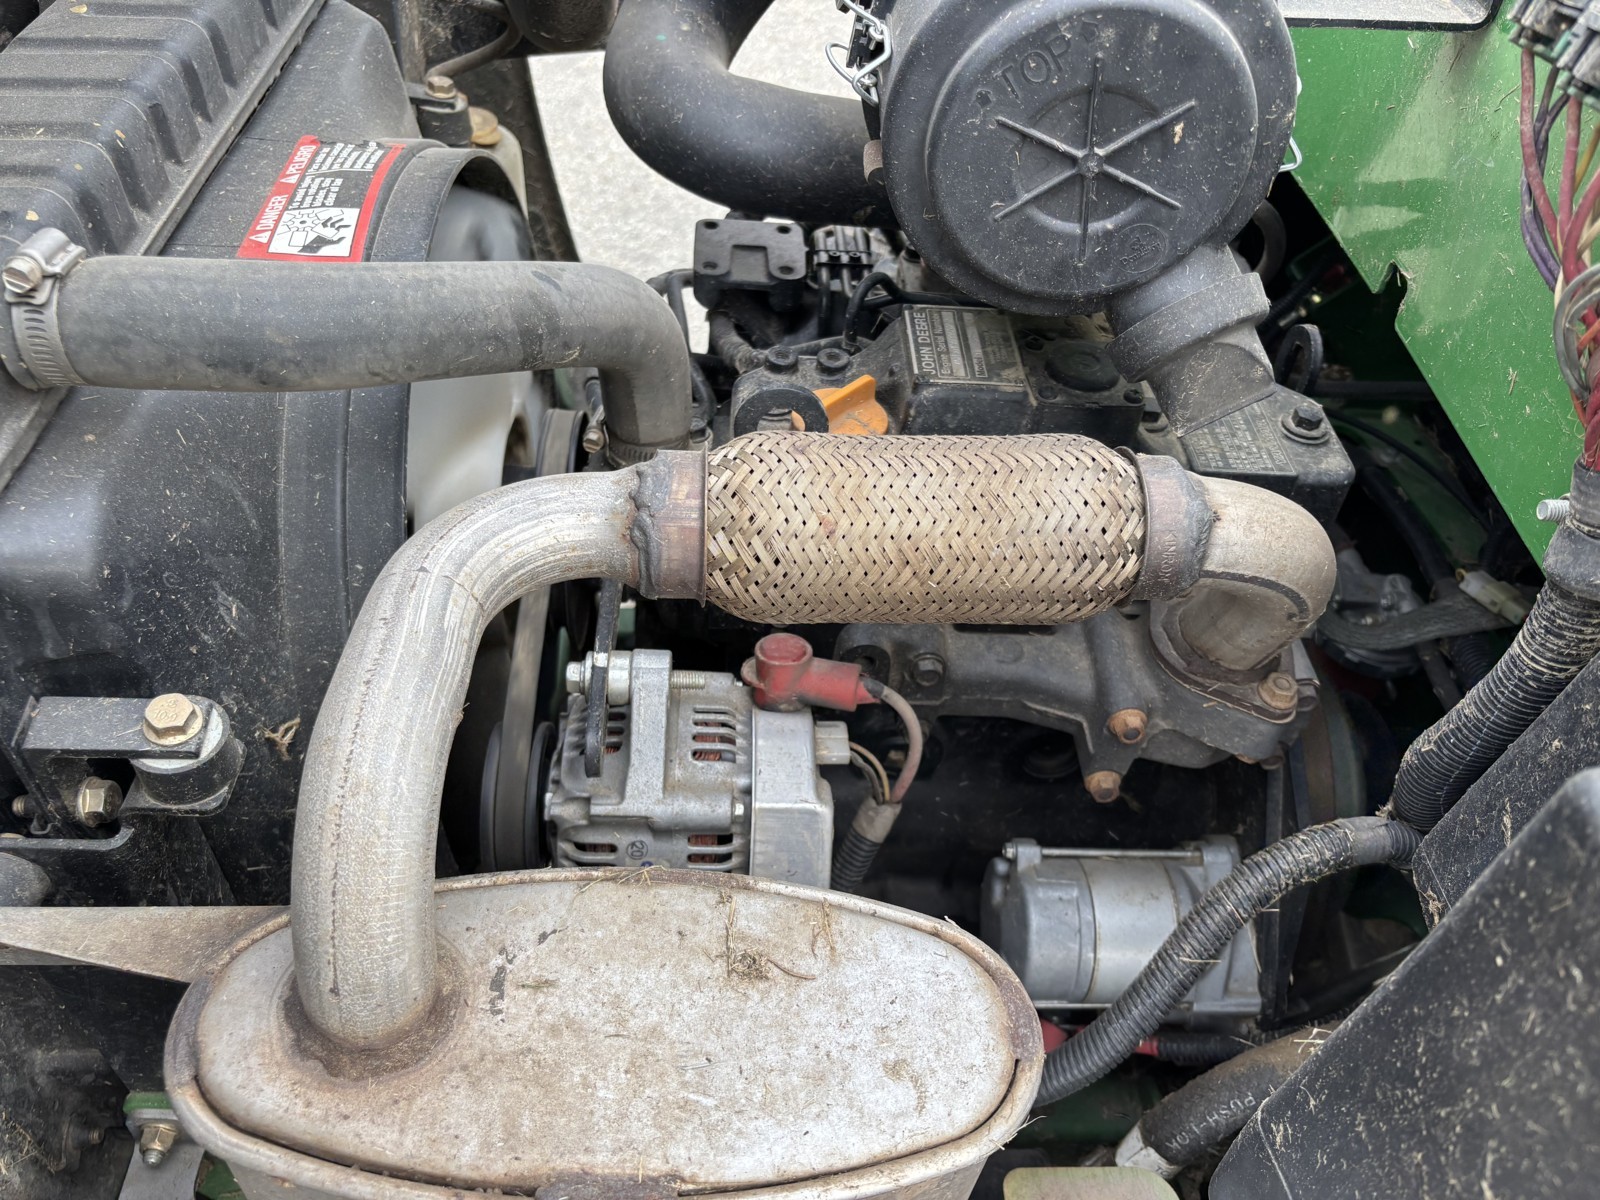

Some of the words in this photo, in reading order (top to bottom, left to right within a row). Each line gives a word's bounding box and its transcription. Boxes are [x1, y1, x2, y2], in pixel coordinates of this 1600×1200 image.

[993, 34, 1071, 103] TOP
[286, 145, 317, 174] PELIGRO
[256, 194, 289, 230] DANGER
[913, 312, 930, 344] DEERE
[935, 335, 946, 352] Serial
[919, 346, 936, 375] JOHN
[974, 357, 986, 376] Model
[631, 841, 645, 857] 20
